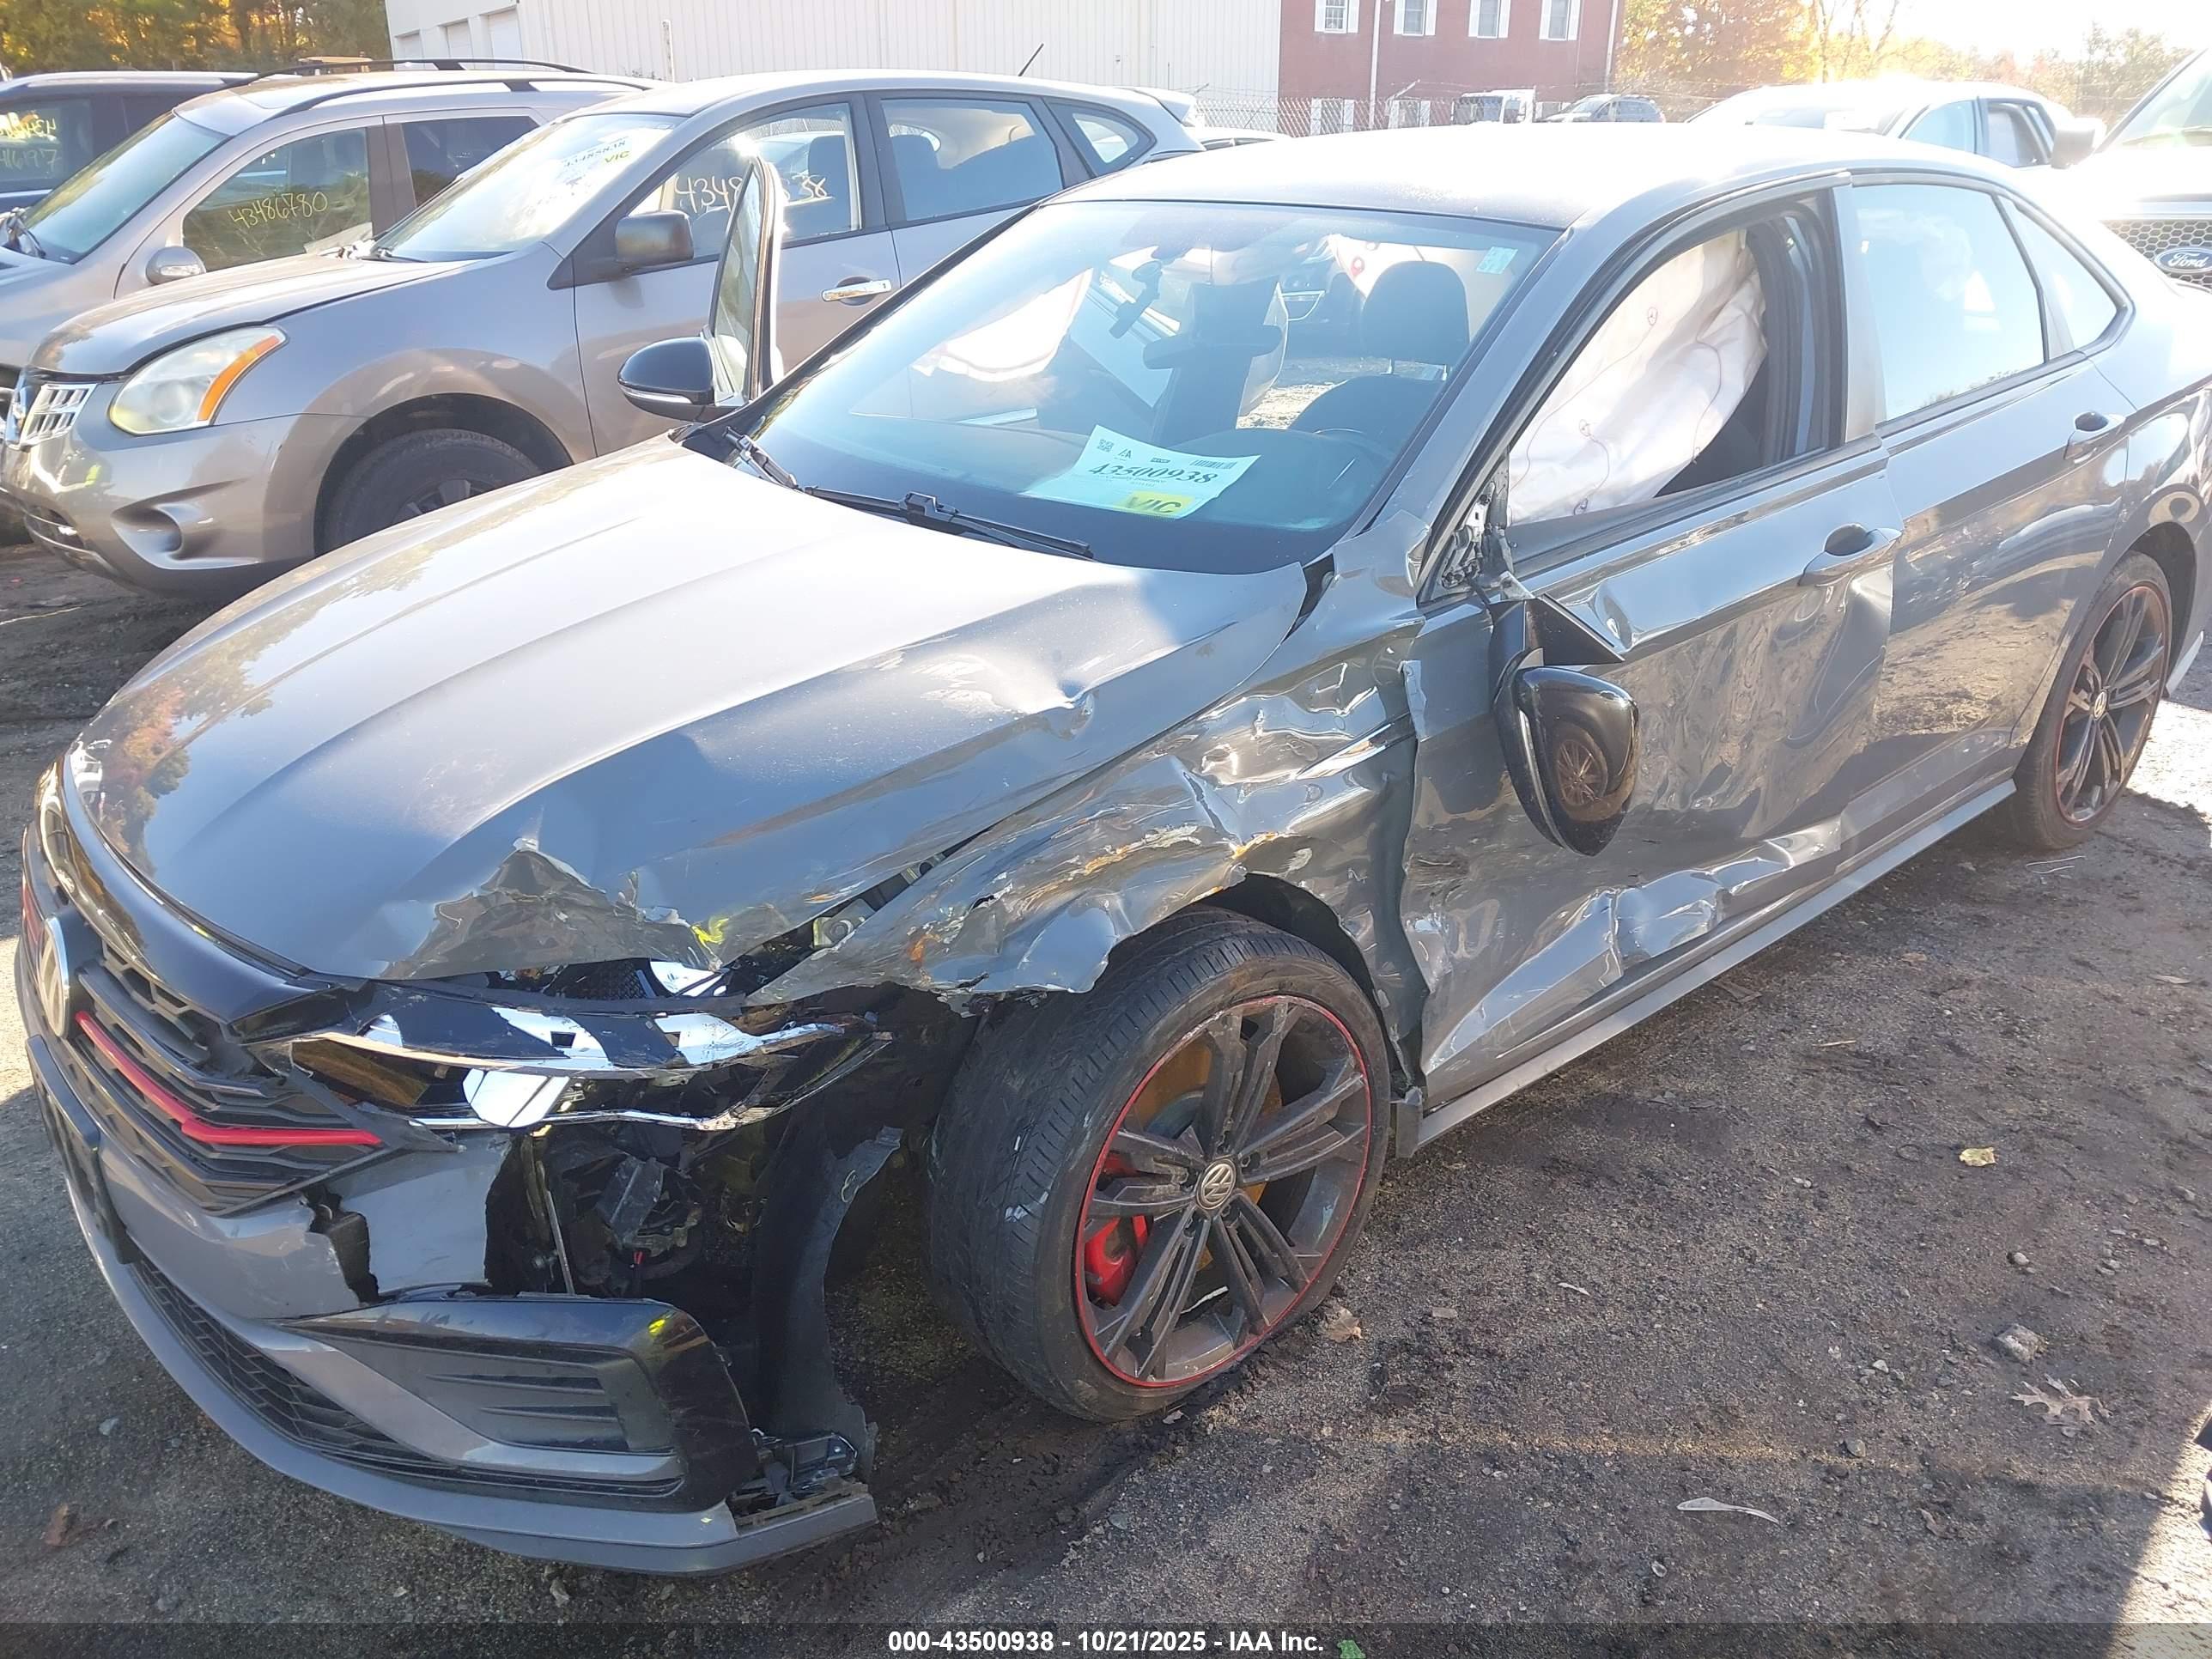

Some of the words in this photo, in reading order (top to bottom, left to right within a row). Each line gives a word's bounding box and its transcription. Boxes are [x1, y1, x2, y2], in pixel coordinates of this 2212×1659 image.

[605, 150, 630, 163] VIC
[228, 191, 328, 228] 43486780
[2168, 252, 2209, 267] Ford
[1089, 462, 1218, 484] 43500938
[1126, 496, 1182, 514] VIC
